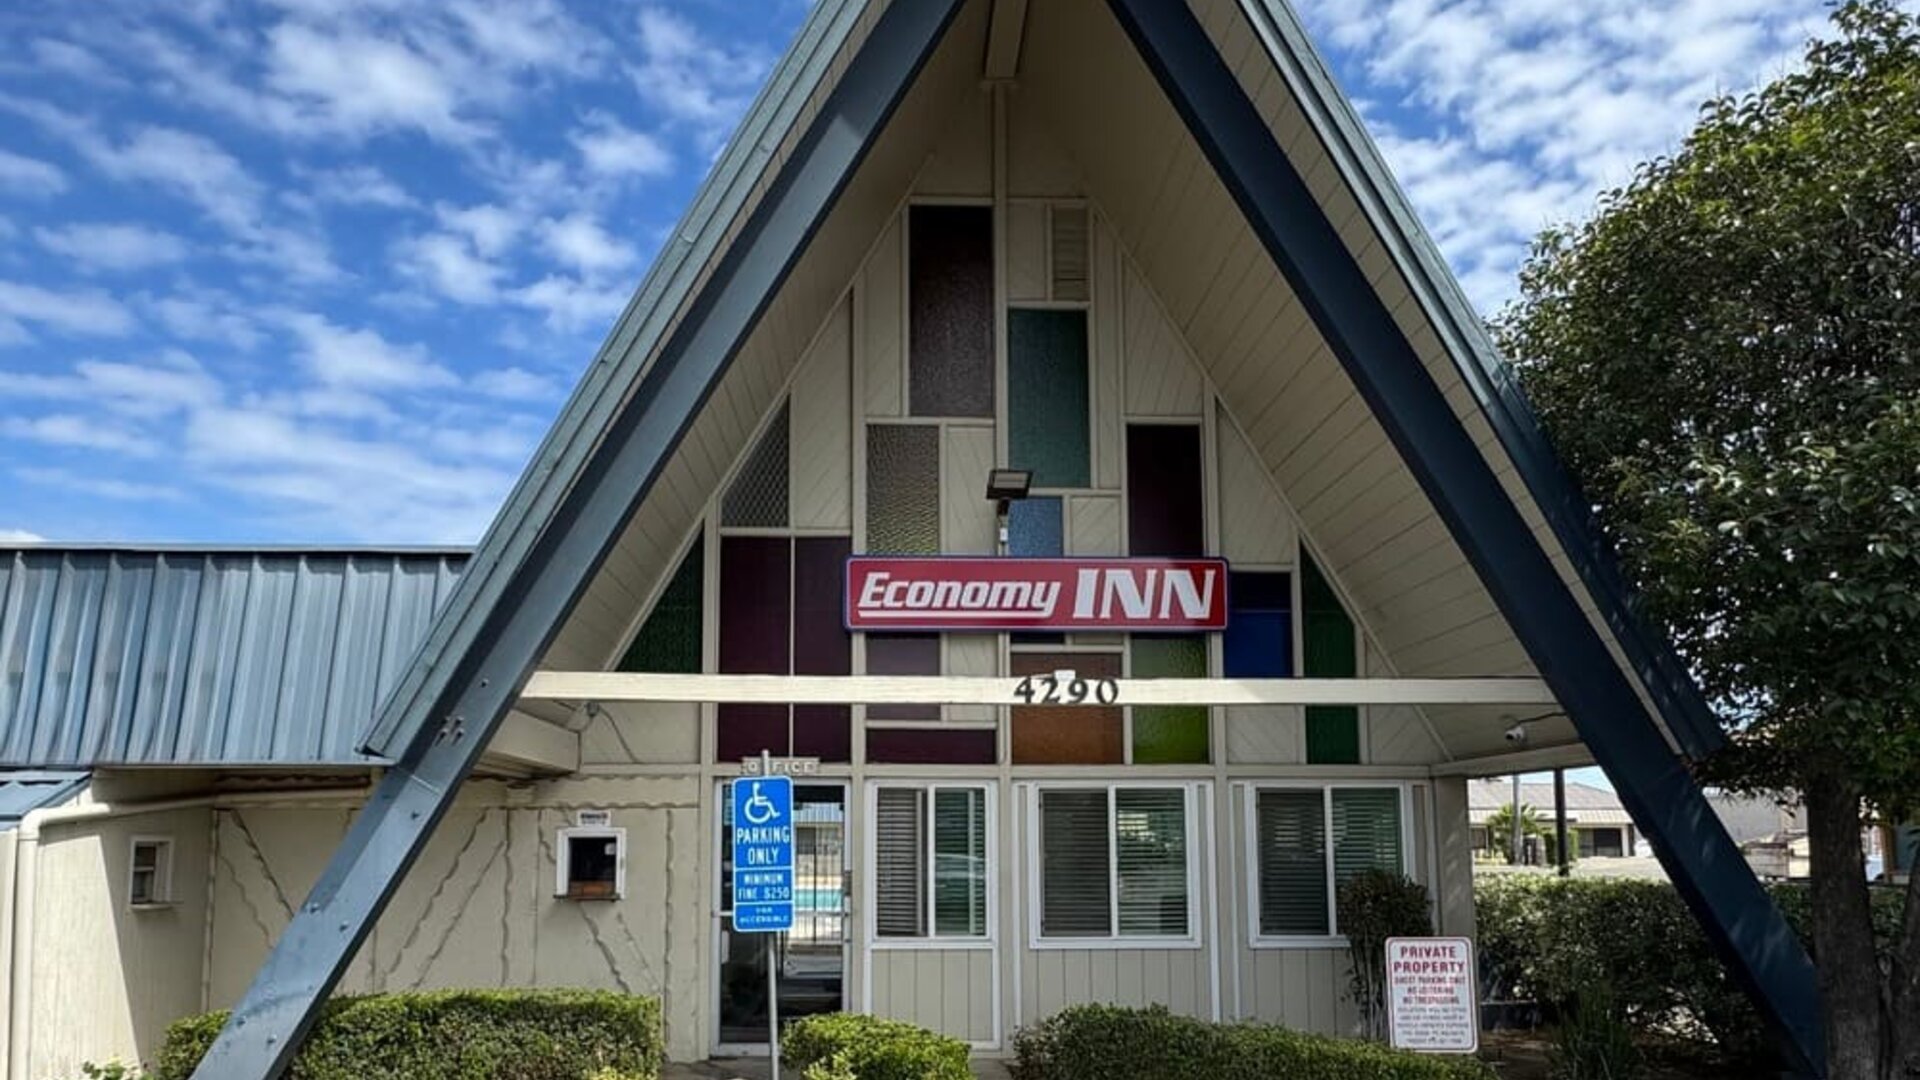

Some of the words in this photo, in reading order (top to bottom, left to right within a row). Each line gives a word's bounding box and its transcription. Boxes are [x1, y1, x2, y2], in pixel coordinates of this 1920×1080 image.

[857, 572, 1061, 618] Economy
[1073, 569, 1216, 620] INN
[1013, 676, 1119, 705] 4290
[747, 761, 817, 774] OFICE
[736, 826, 790, 845] PARKING
[748, 847, 779, 865] ONLY
[744, 873, 784, 886] MINIMUM
[739, 887, 758, 900] FINE
[764, 886, 790, 900] $250
[1401, 946, 1456, 958] PRIVATE
[1394, 961, 1464, 973] PROPERTY
